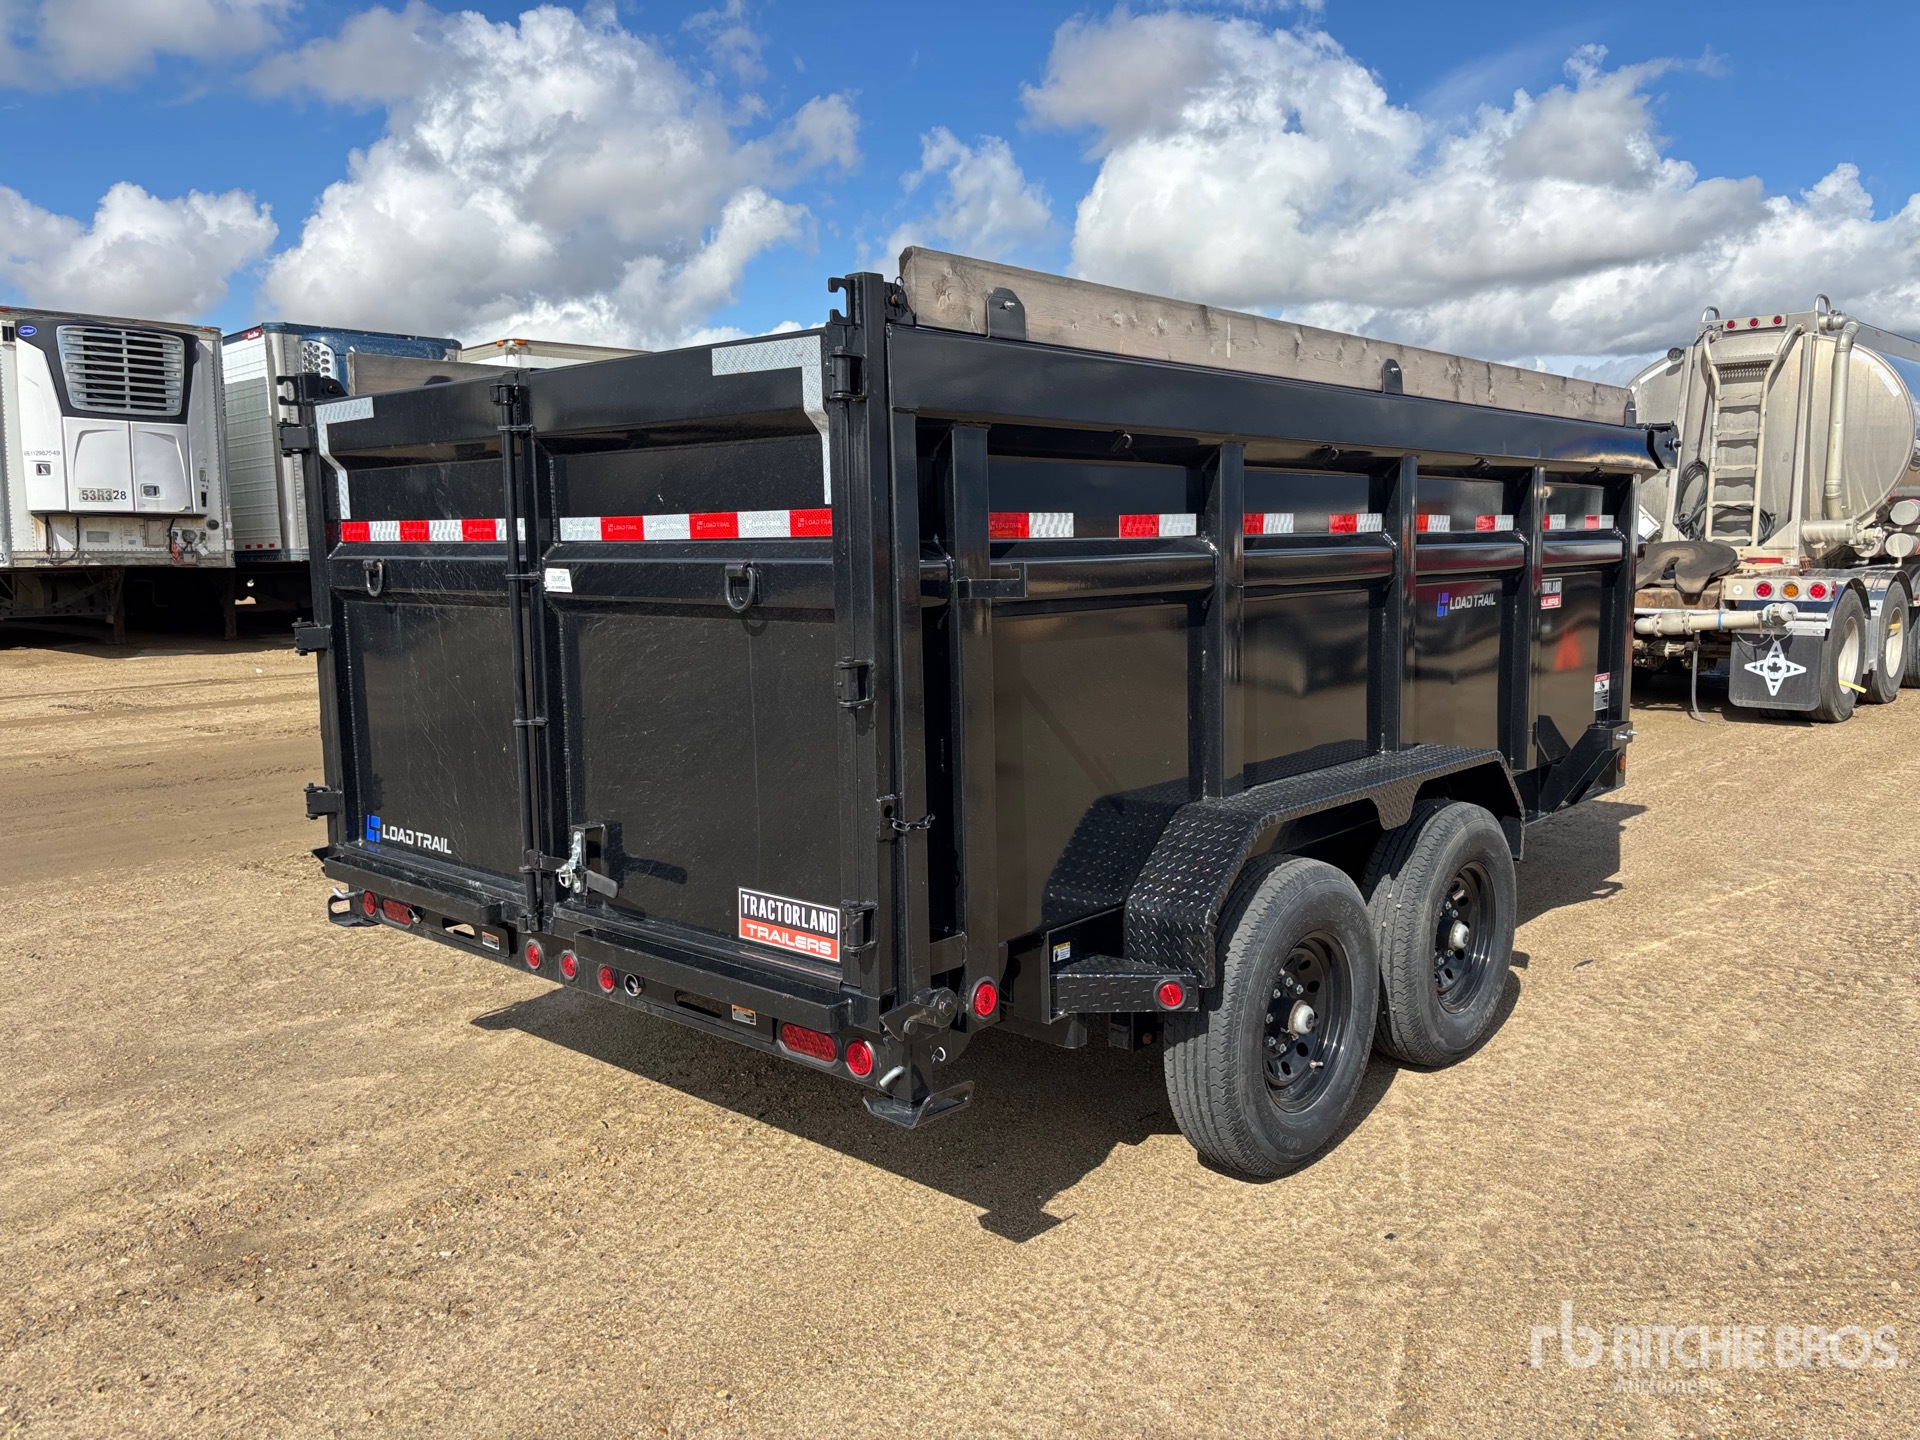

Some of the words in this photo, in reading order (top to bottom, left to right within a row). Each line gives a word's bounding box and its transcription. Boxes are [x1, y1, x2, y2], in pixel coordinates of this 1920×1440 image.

[1450, 595, 1473, 610] LOAD
[1473, 593, 1496, 608] TRAIL
[382, 823, 415, 846] LOAD
[415, 831, 452, 854] TRAIL
[741, 893, 837, 934] TRACTORLAND
[746, 923, 832, 956] TRAILERS
